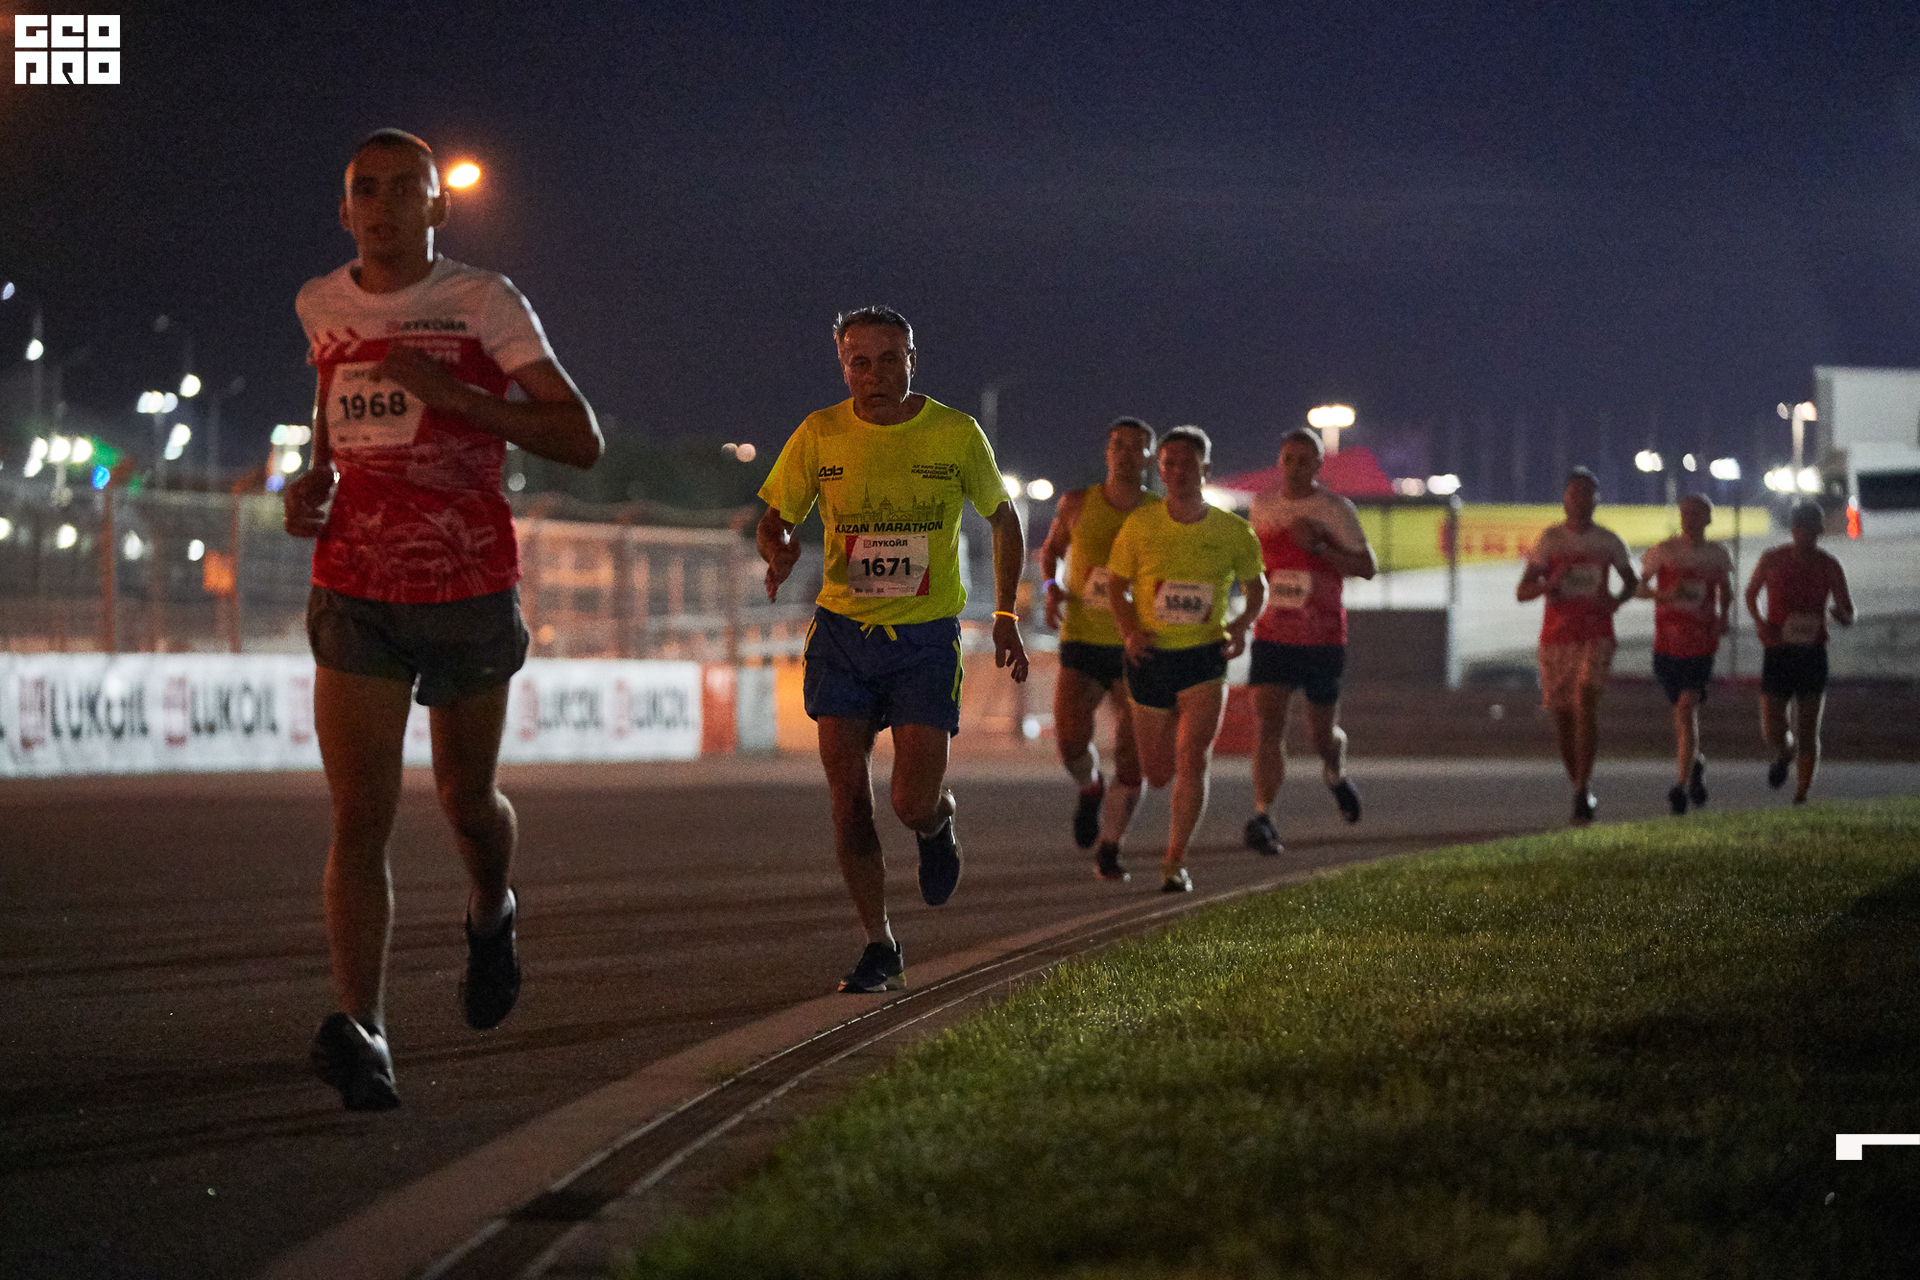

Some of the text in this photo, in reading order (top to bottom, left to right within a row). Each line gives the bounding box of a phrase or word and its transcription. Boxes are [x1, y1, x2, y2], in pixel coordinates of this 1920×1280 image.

[339, 390, 408, 420] 1968
[835, 520, 943, 534] KAZAN MARATHON
[872, 539, 908, 547] ЛУКОЙЛ
[861, 557, 911, 576] 1671
